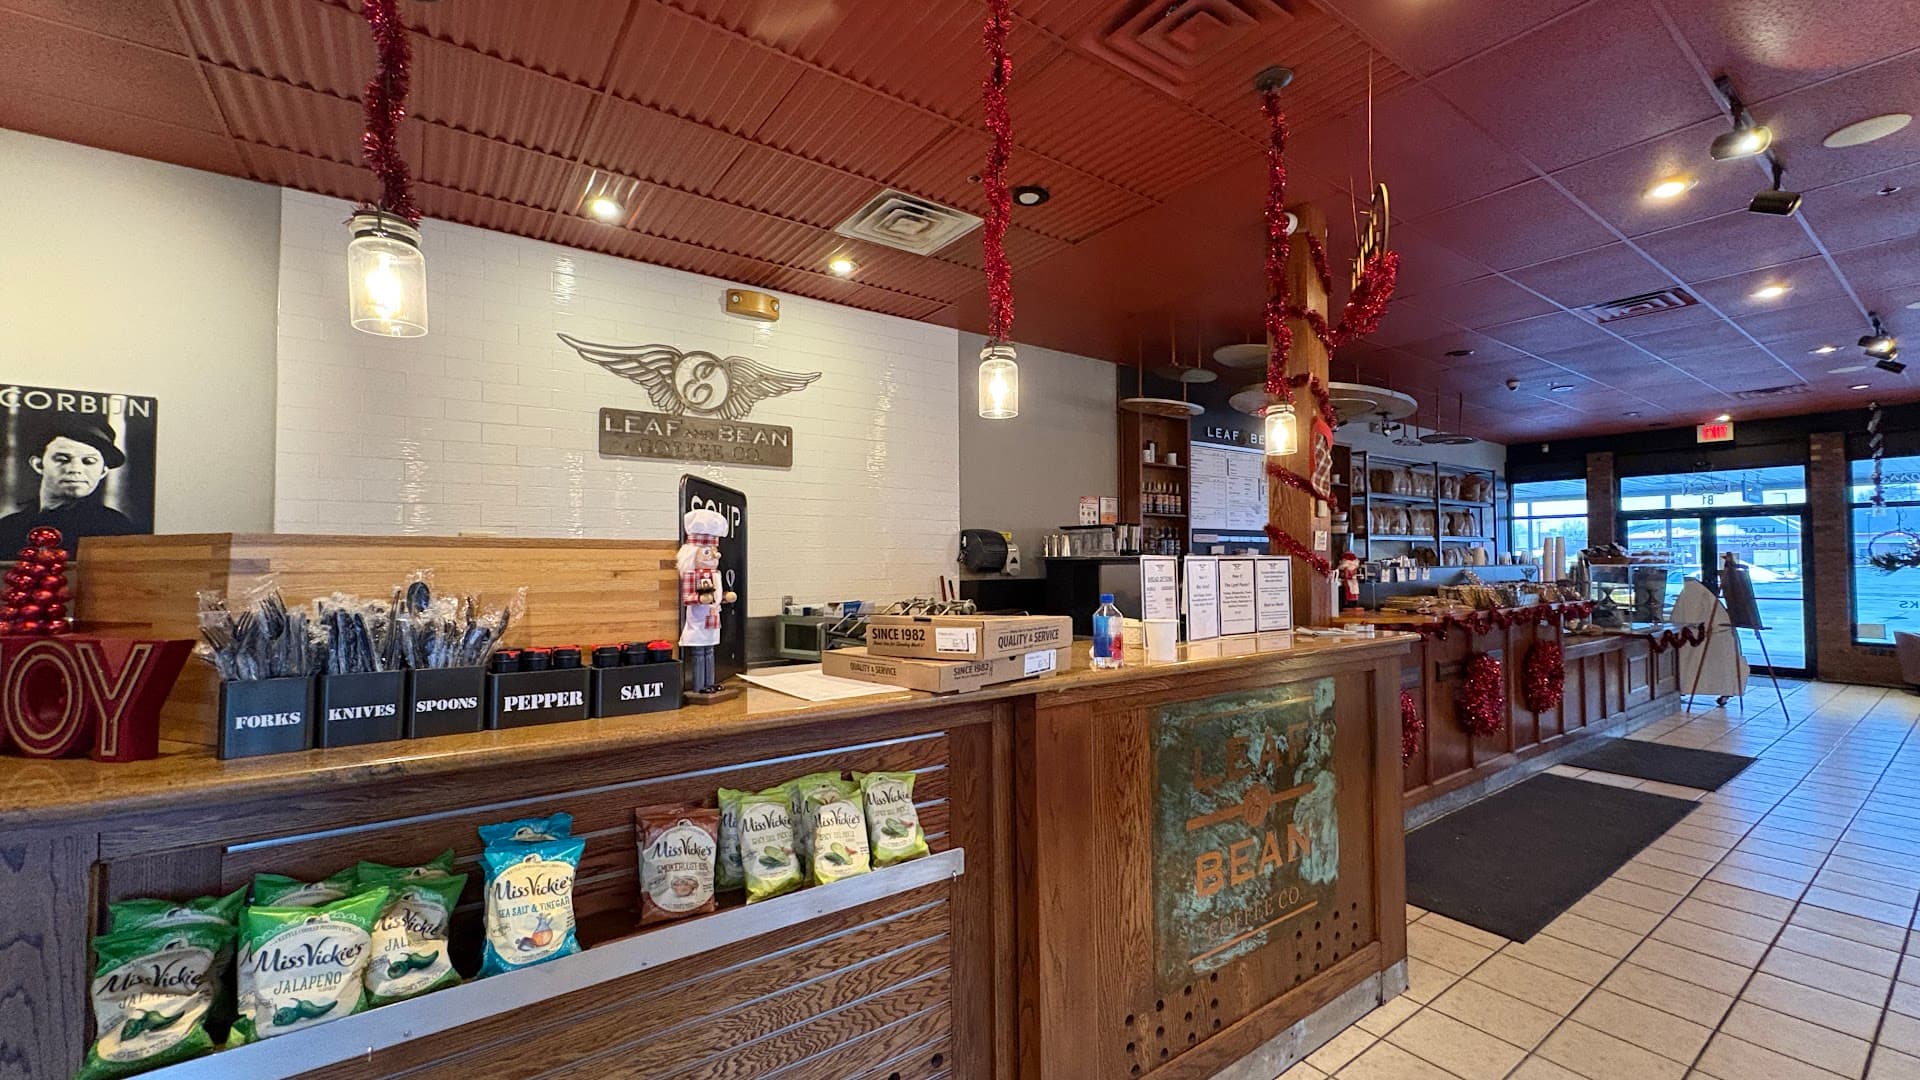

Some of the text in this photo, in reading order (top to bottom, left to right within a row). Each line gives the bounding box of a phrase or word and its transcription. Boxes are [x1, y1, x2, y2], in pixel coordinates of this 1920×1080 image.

[604, 413, 683, 437] LEAF
[718, 425, 788, 447] BEAN
[1207, 426, 1265, 445] LEAF BE
[872, 628, 926, 641] SINCE 1982
[997, 632, 1028, 648] QUALITY
[1034, 629, 1060, 643] SERVICE
[849, 662, 870, 673] QUALITY
[953, 665, 973, 676] SINCE
[0, 638, 154, 757] OY
[503, 690, 583, 712] PEPPER
[620, 682, 664, 701] SALT
[328, 703, 396, 721] KNIVES
[416, 696, 478, 713] SPOONS
[234, 711, 301, 730] FORKS
[881, 786, 910, 804] Vickie
[741, 817, 766, 834] Miss
[762, 810, 793, 830] Vickie
[652, 835, 713, 861] Miss Vickie's
[1195, 823, 1311, 899] BEAN
[496, 873, 573, 900] Miss Vickie's
[497, 896, 570, 919] SEA SALT & VINEGAR
[1207, 896, 1274, 941] COFFEE
[403, 908, 441, 940] Vickie
[253, 948, 304, 973] Miss
[300, 936, 368, 968] Vickie's
[96, 959, 205, 997] Miss Vickie
